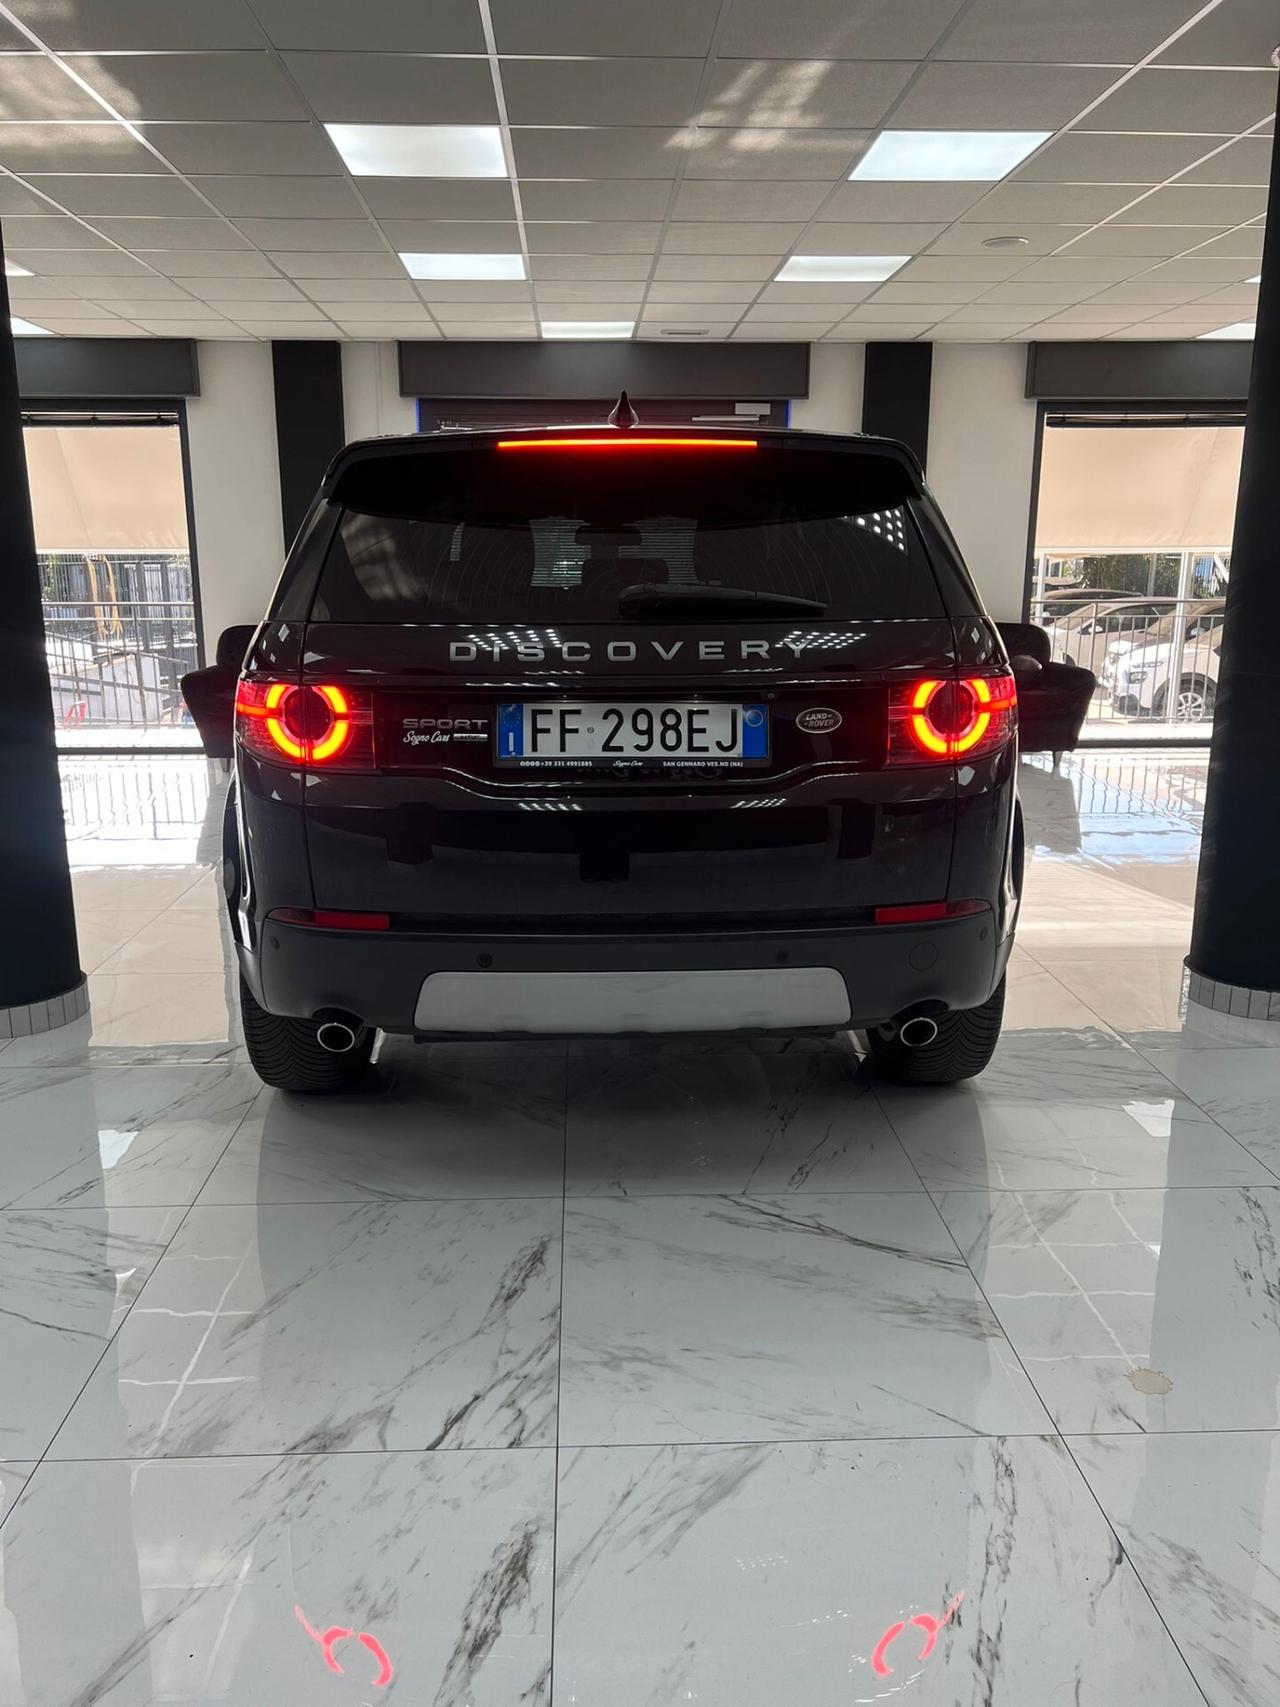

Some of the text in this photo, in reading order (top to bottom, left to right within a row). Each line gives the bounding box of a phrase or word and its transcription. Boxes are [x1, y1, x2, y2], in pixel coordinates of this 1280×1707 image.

[449, 640, 812, 662] DISCOVERY
[806, 712, 827, 721] LAND
[402, 718, 488, 730] SPORT
[807, 719, 834, 728] ROVER
[530, 708, 739, 753] FF 298EJ
[403, 731, 430, 745] Sogno
